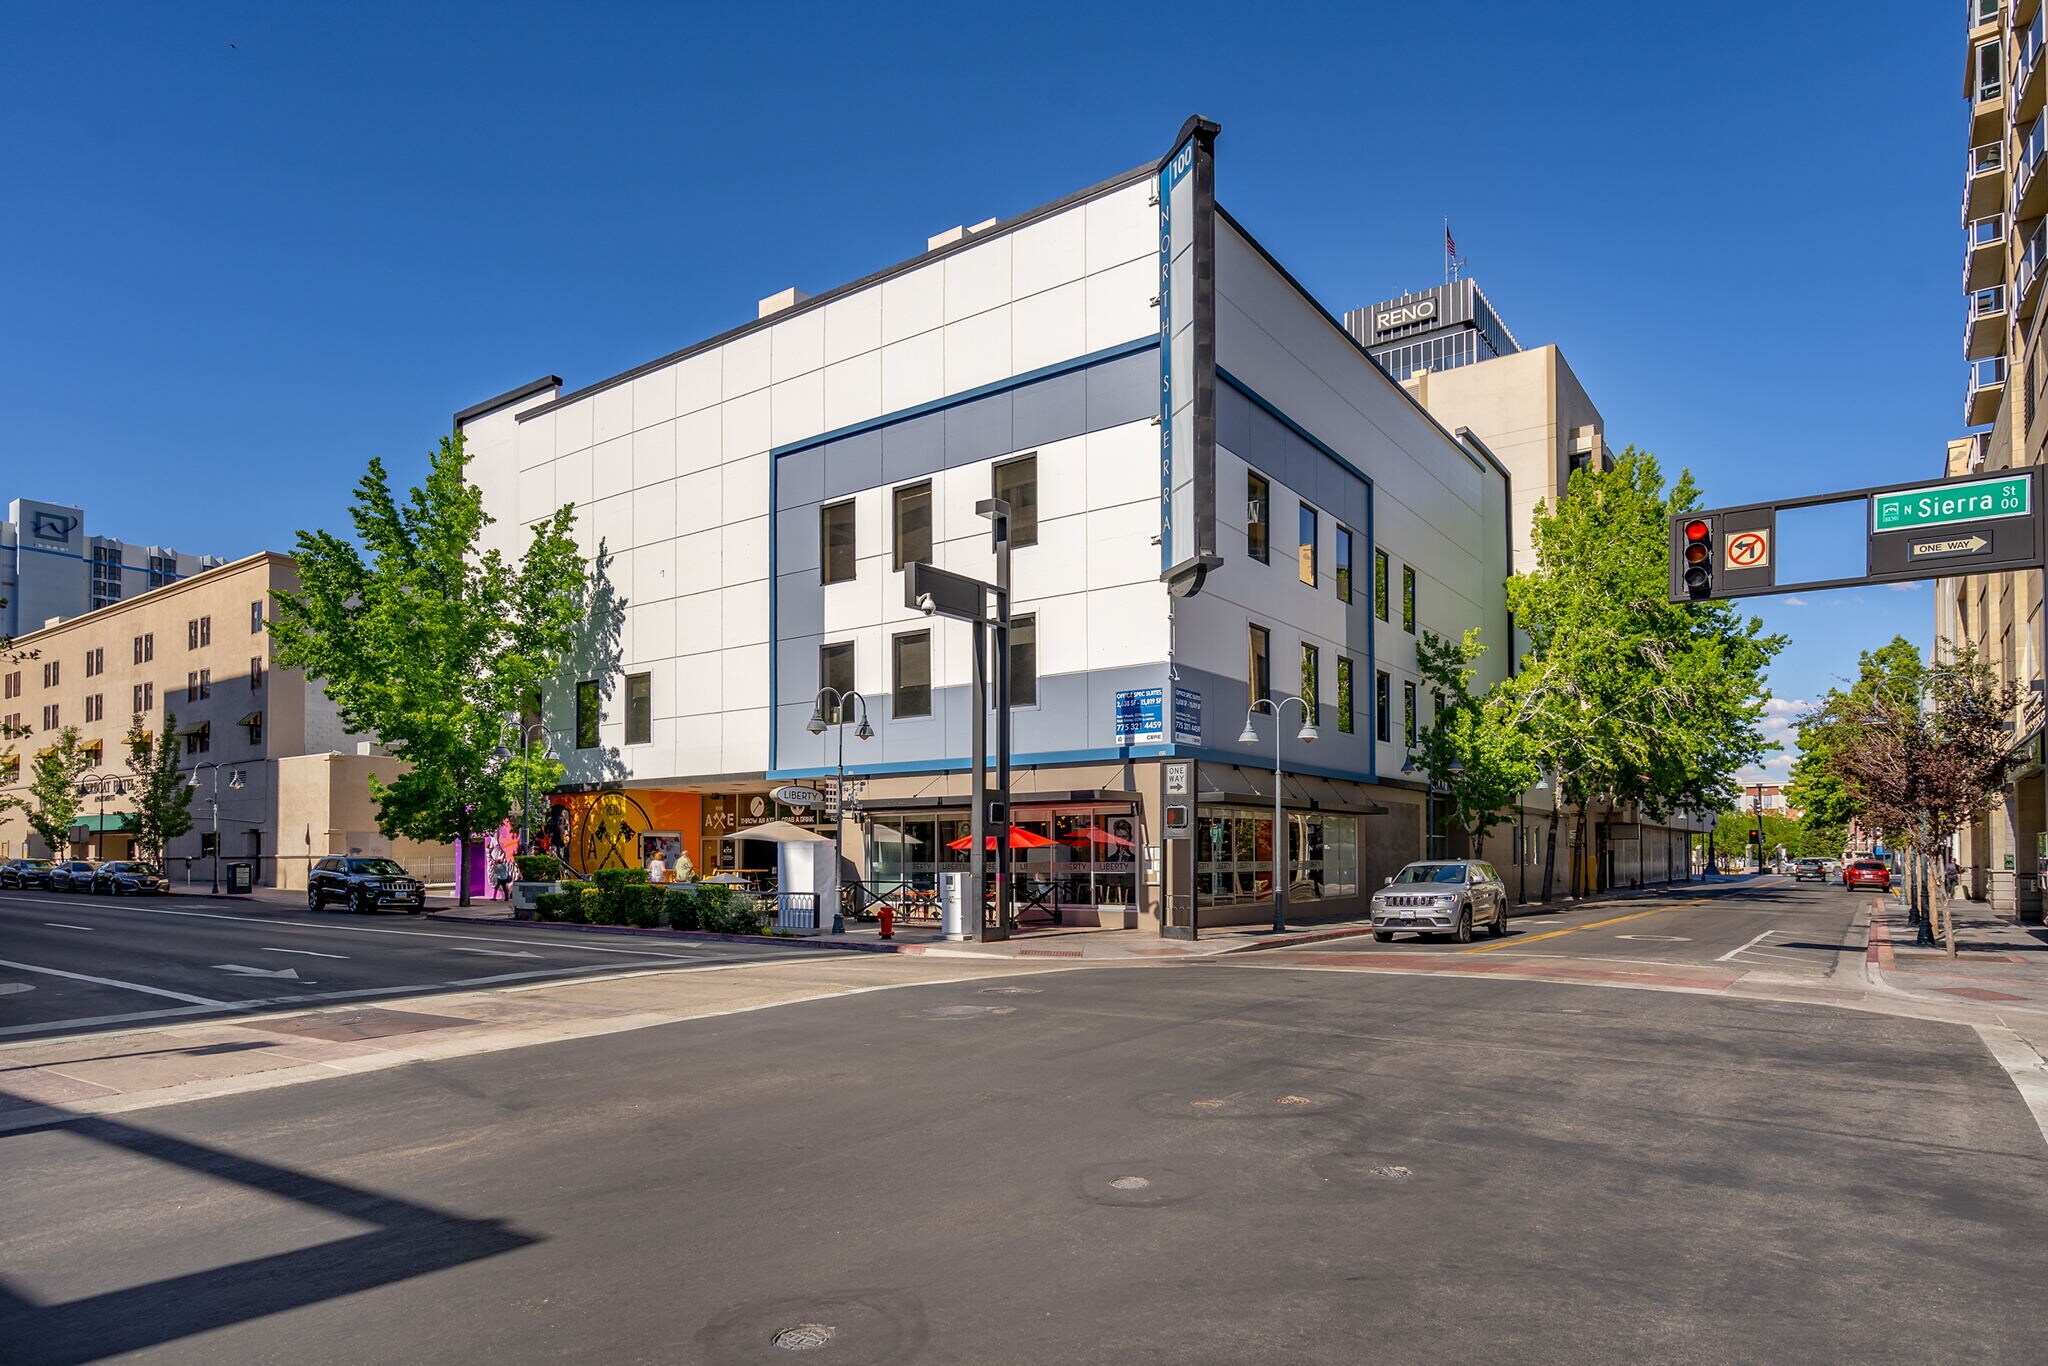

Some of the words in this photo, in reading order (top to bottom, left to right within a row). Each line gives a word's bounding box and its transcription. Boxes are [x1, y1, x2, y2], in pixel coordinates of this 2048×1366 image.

[1172, 145, 1192, 180] 100
[1161, 205, 1170, 338] NORTH
[1377, 301, 1434, 329] RENO
[1163, 375, 1171, 533] SIERRA
[1904, 504, 1912, 515] N
[1917, 495, 1993, 518] Sierra
[2002, 486, 2016, 497] St
[2000, 497, 2019, 509] 00
[1919, 543, 1942, 553] ONE
[1948, 540, 1970, 550] WAY
[1116, 723, 1129, 731] 775
[1144, 721, 1162, 729] 4459
[1169, 767, 1184, 775] ONE
[784, 790, 818, 801] LIBERTY
